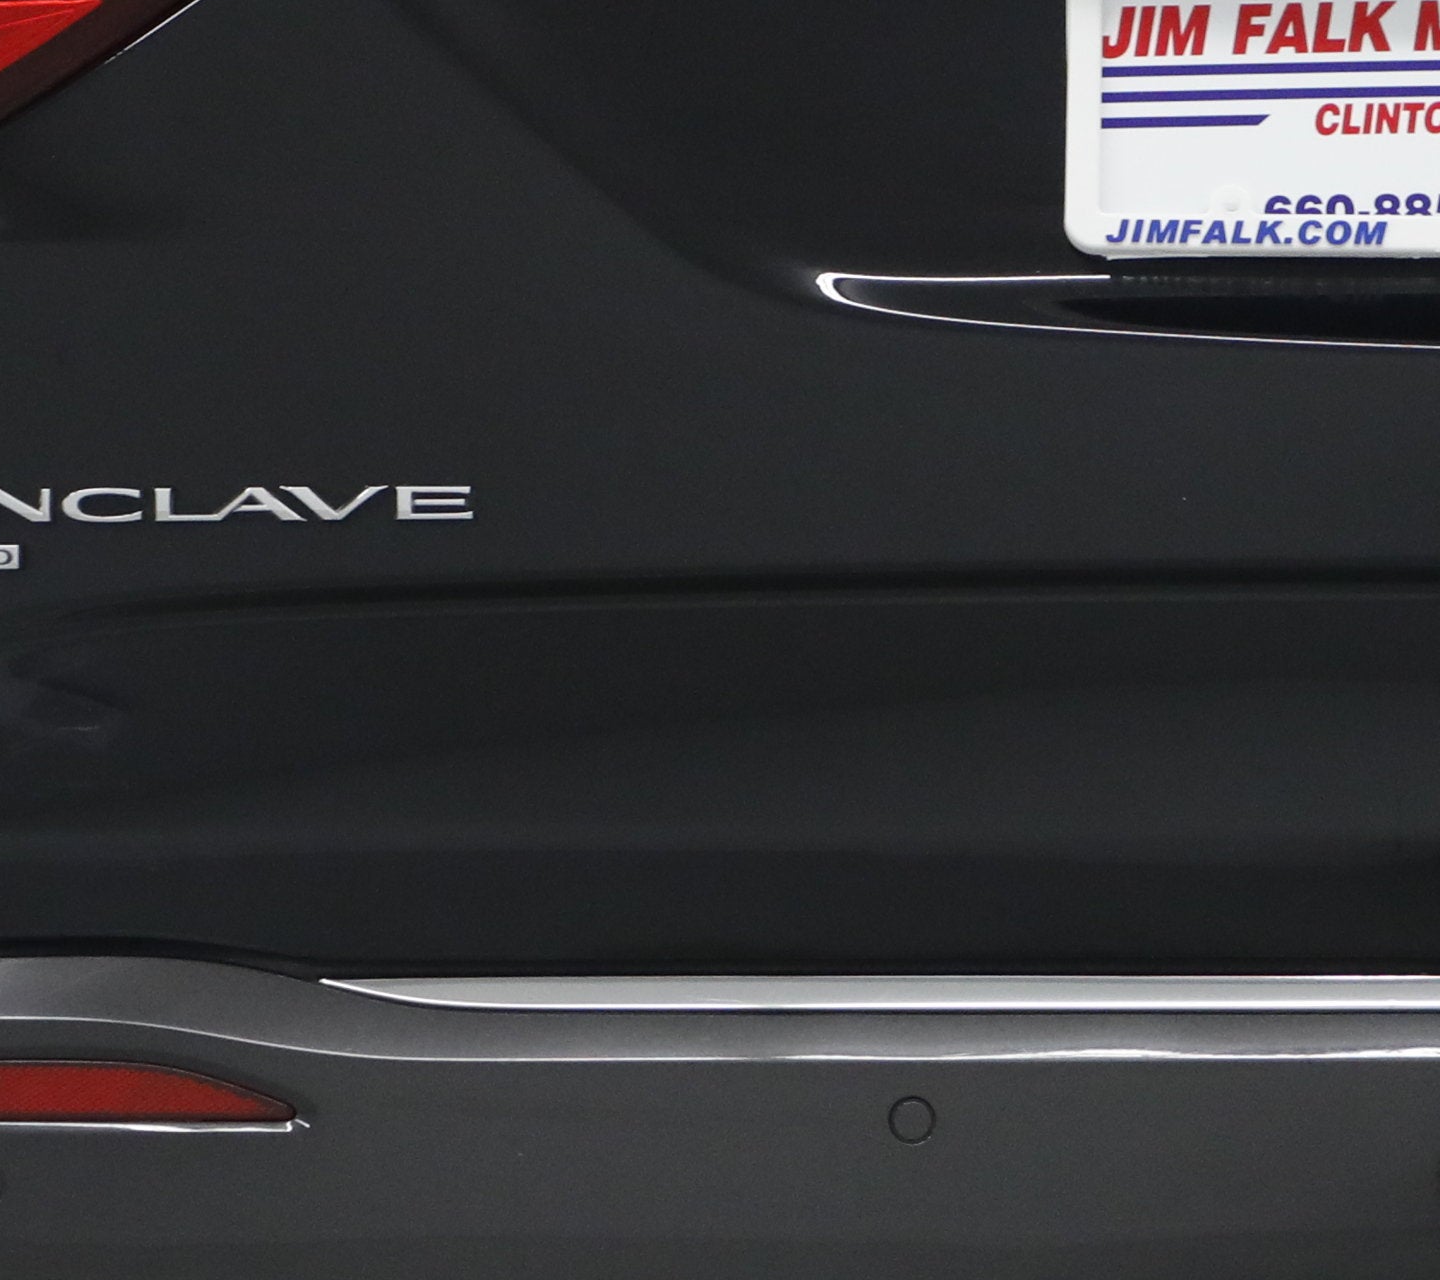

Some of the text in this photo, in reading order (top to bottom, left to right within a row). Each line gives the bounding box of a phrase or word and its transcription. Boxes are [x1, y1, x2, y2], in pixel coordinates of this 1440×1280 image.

[1102, 4, 1211, 59] JIM
[1232, 0, 1396, 55] FALK
[1106, 219, 1388, 245] JIMFALK.COM
